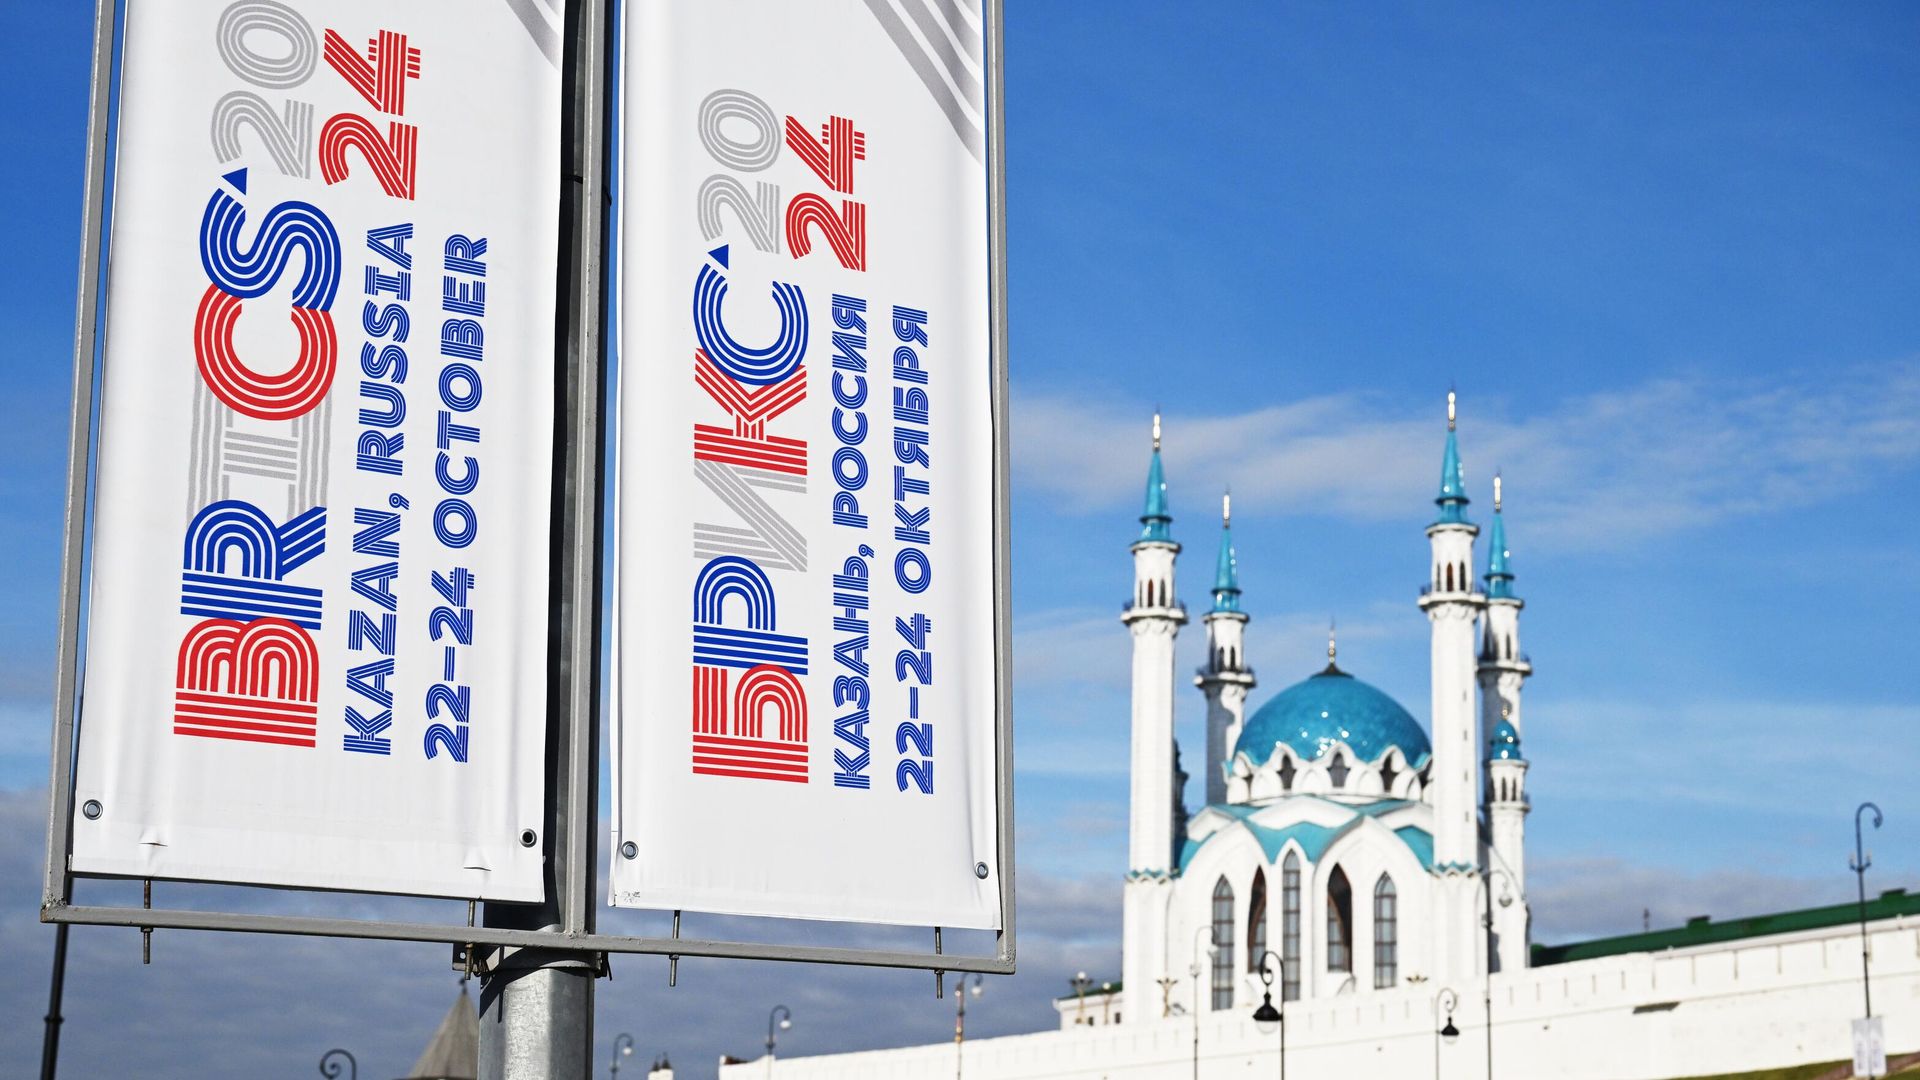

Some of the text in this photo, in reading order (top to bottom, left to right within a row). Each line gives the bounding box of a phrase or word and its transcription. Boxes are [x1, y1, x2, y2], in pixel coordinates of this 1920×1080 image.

[319, 28, 420, 200] 24
[786, 115, 866, 272] 24
[173, 0, 341, 748] BRICS 20
[343, 223, 413, 755] KAZAN, RUSSIA
[433, 234, 487, 549] OCTOBER
[692, 89, 809, 783] БРИКС 20
[832, 294, 875, 789] КАЗАНЬ, РОССИЯ
[893, 305, 931, 594] ОКТЯБРЯ
